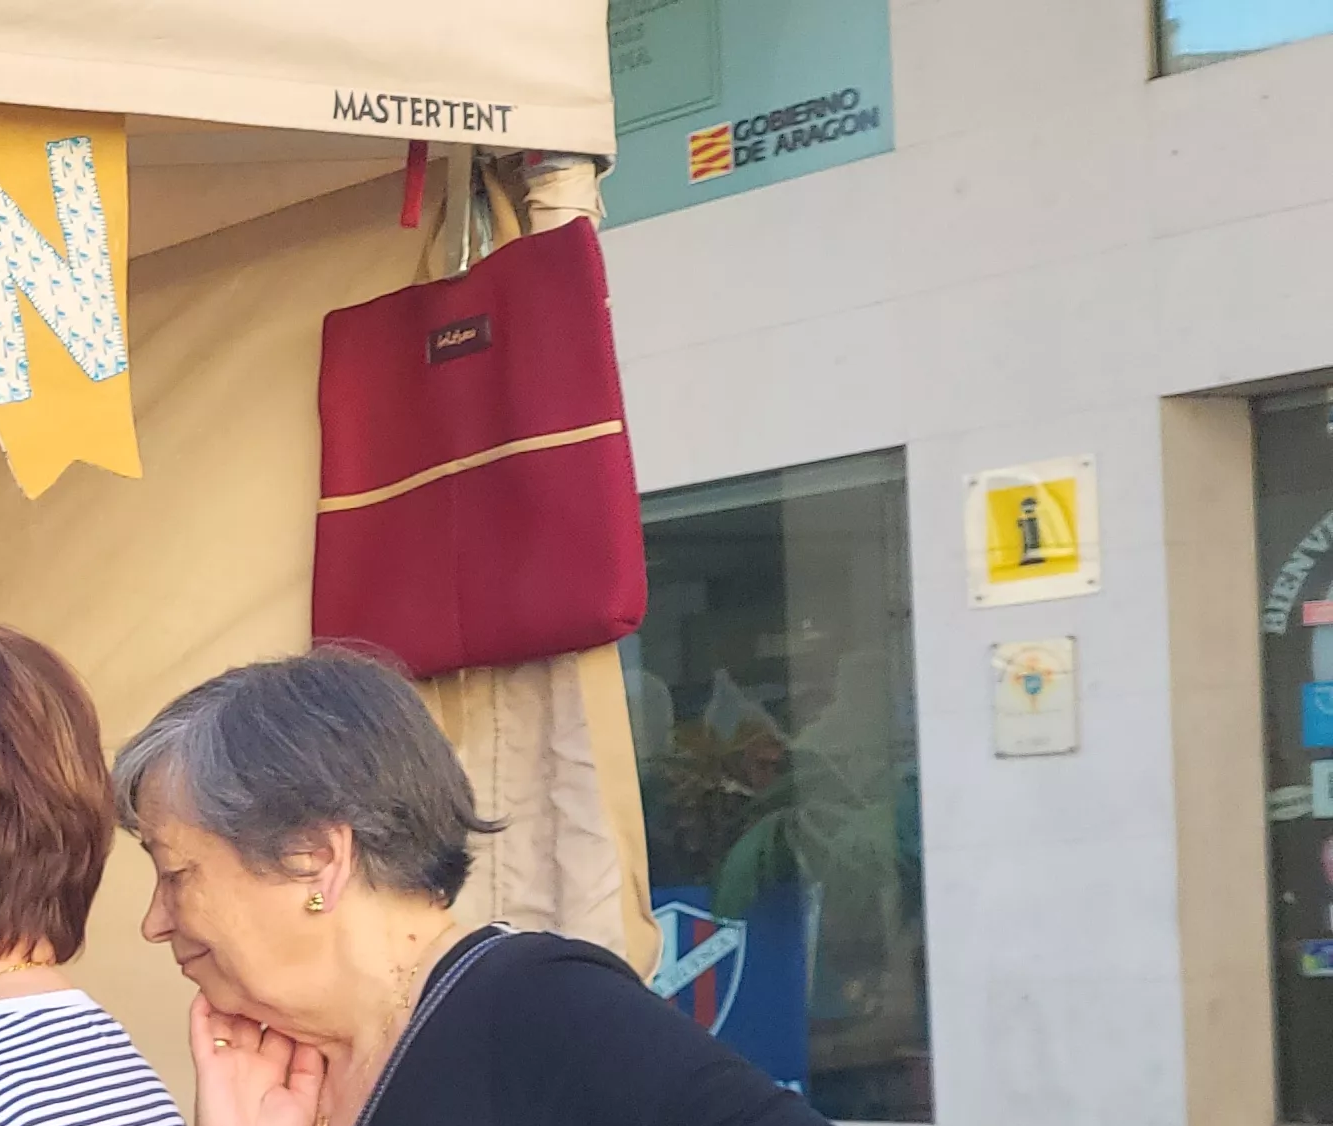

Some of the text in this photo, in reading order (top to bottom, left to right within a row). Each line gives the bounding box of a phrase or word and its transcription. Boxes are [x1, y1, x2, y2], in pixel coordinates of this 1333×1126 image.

[333, 89, 512, 133] MASTERTENT
[734, 88, 865, 141] GOBIERNO
[734, 140, 766, 167] DE
